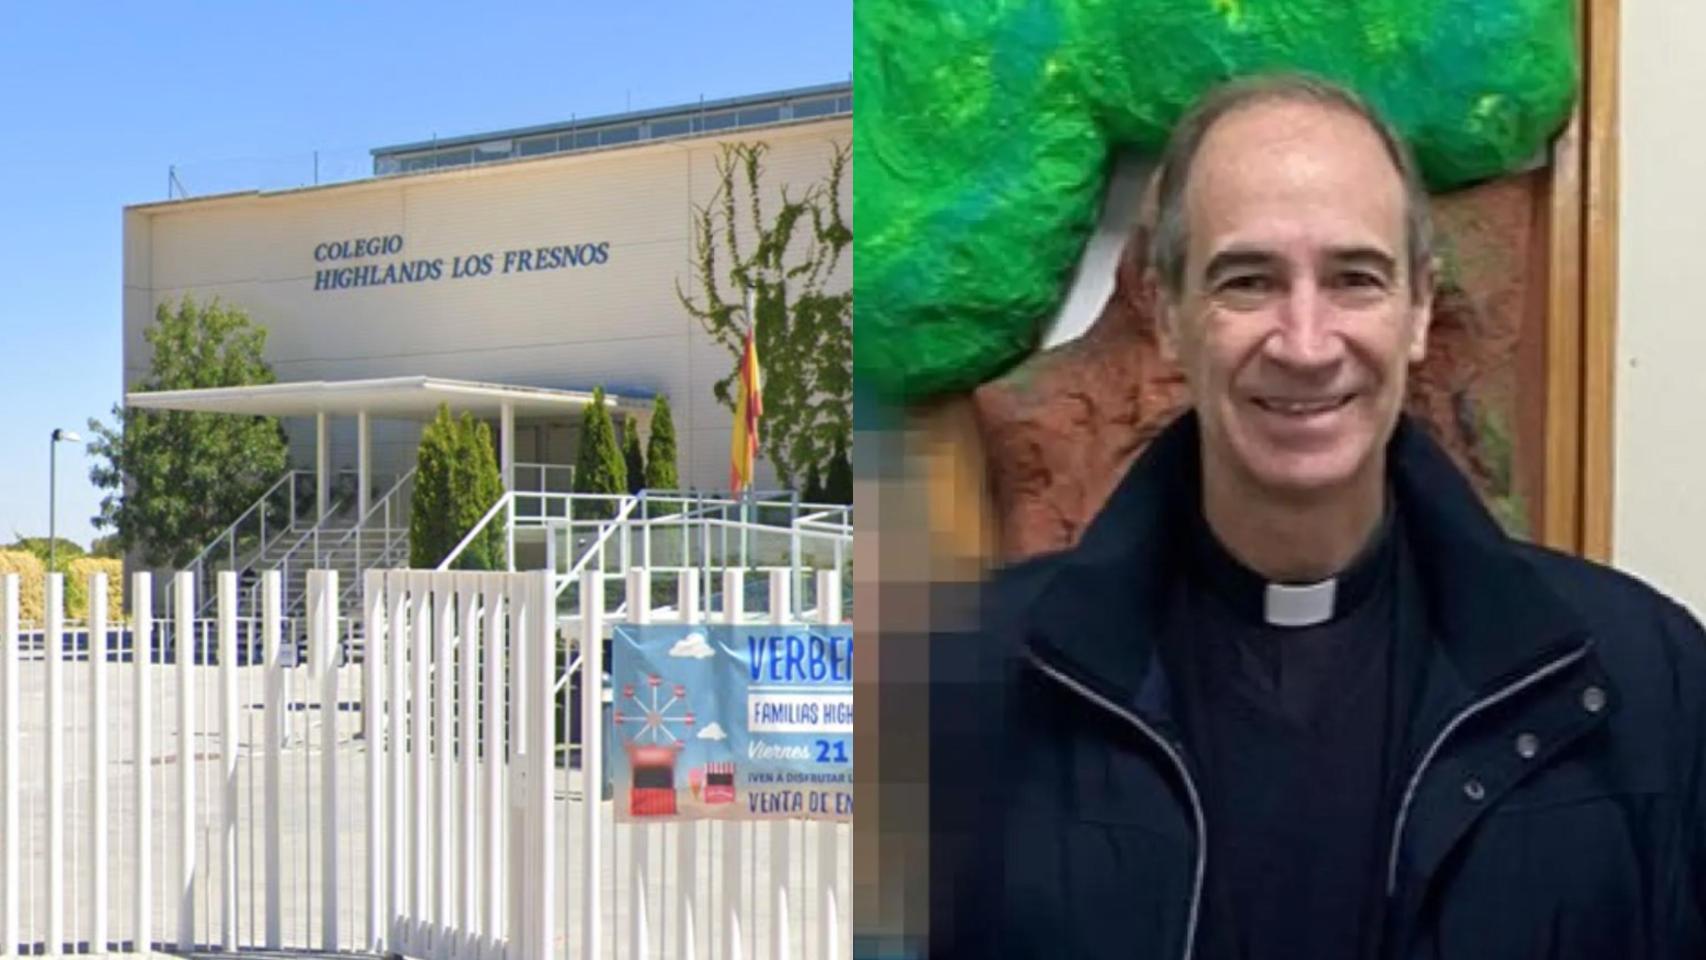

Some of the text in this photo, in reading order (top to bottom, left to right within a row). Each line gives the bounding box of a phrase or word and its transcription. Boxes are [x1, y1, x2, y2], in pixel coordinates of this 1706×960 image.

[314, 234, 404, 262] COLEGIO
[314, 241, 610, 291] HIGHLANDS LOS FRESNOS
[754, 702, 819, 724] FAMILIAS
[748, 739, 848, 763] Viernes 21
[776, 772, 784, 783] A
[787, 772, 845, 783] DISFRUTAR
[748, 790, 803, 813] VENTA
[809, 790, 828, 813] DE
